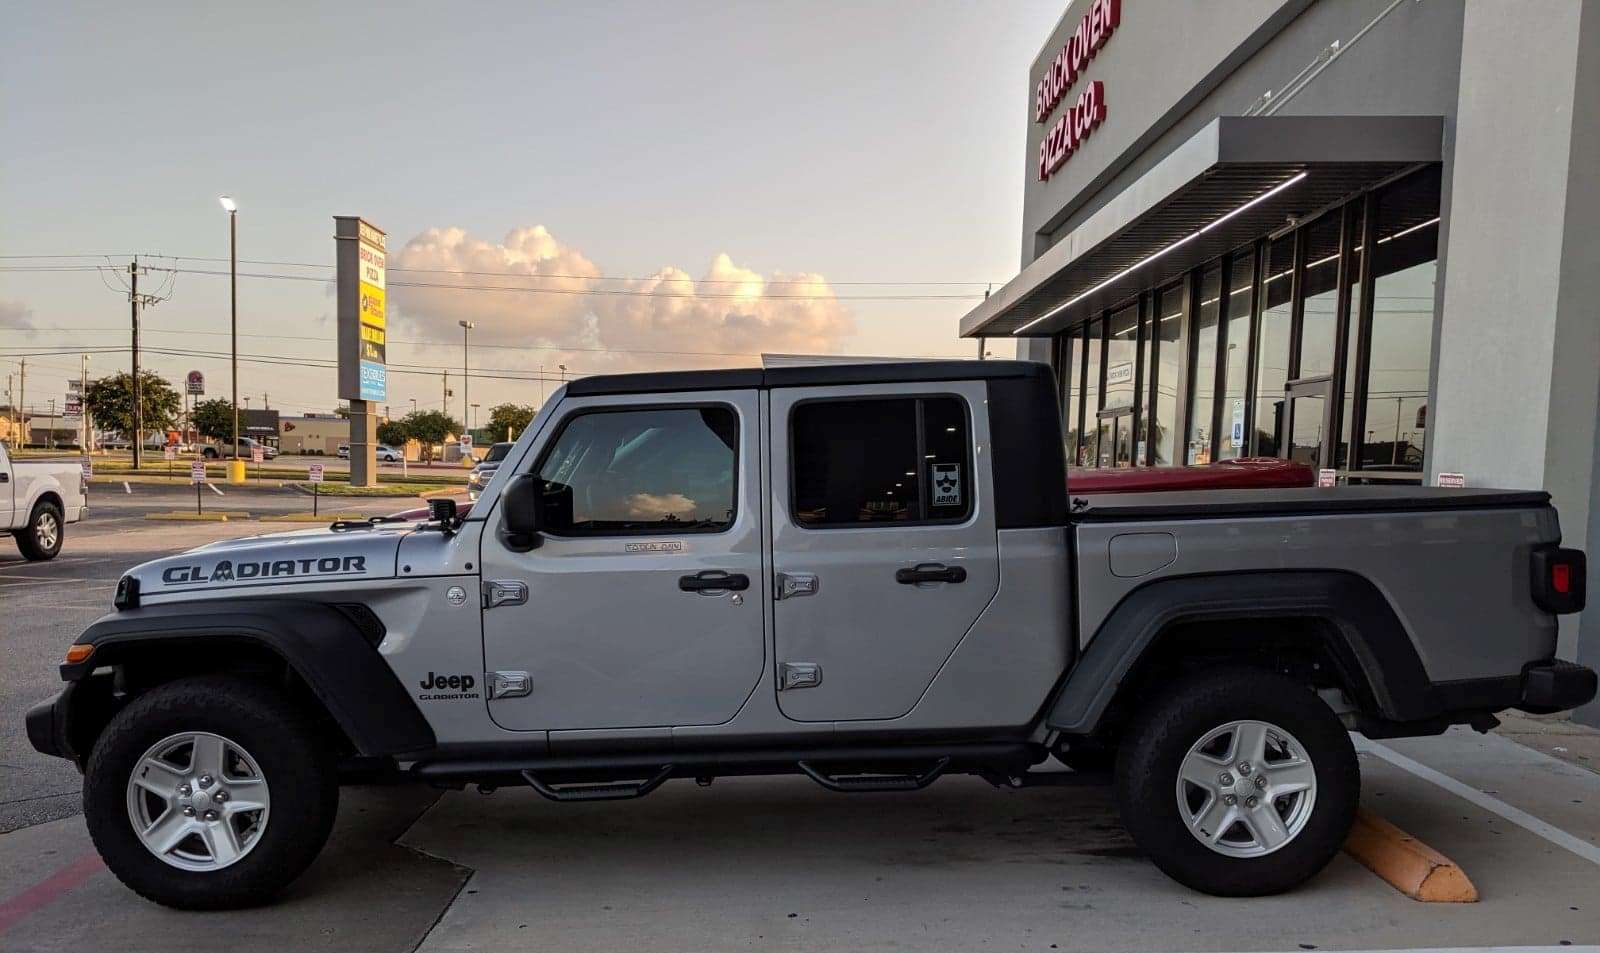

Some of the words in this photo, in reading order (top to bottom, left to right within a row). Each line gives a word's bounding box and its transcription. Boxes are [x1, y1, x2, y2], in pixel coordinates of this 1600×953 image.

[1036, 38, 1077, 123] BRICK
[1073, 0, 1120, 71] OVEN
[1038, 108, 1079, 181] PIZZA
[1075, 81, 1107, 140] CO.
[361, 247, 373, 263] BRICK
[367, 266, 379, 281] PIZZA
[937, 495, 958, 503] ABIDE
[162, 555, 367, 585] GLADIATOR
[420, 672, 475, 691] Jeep
